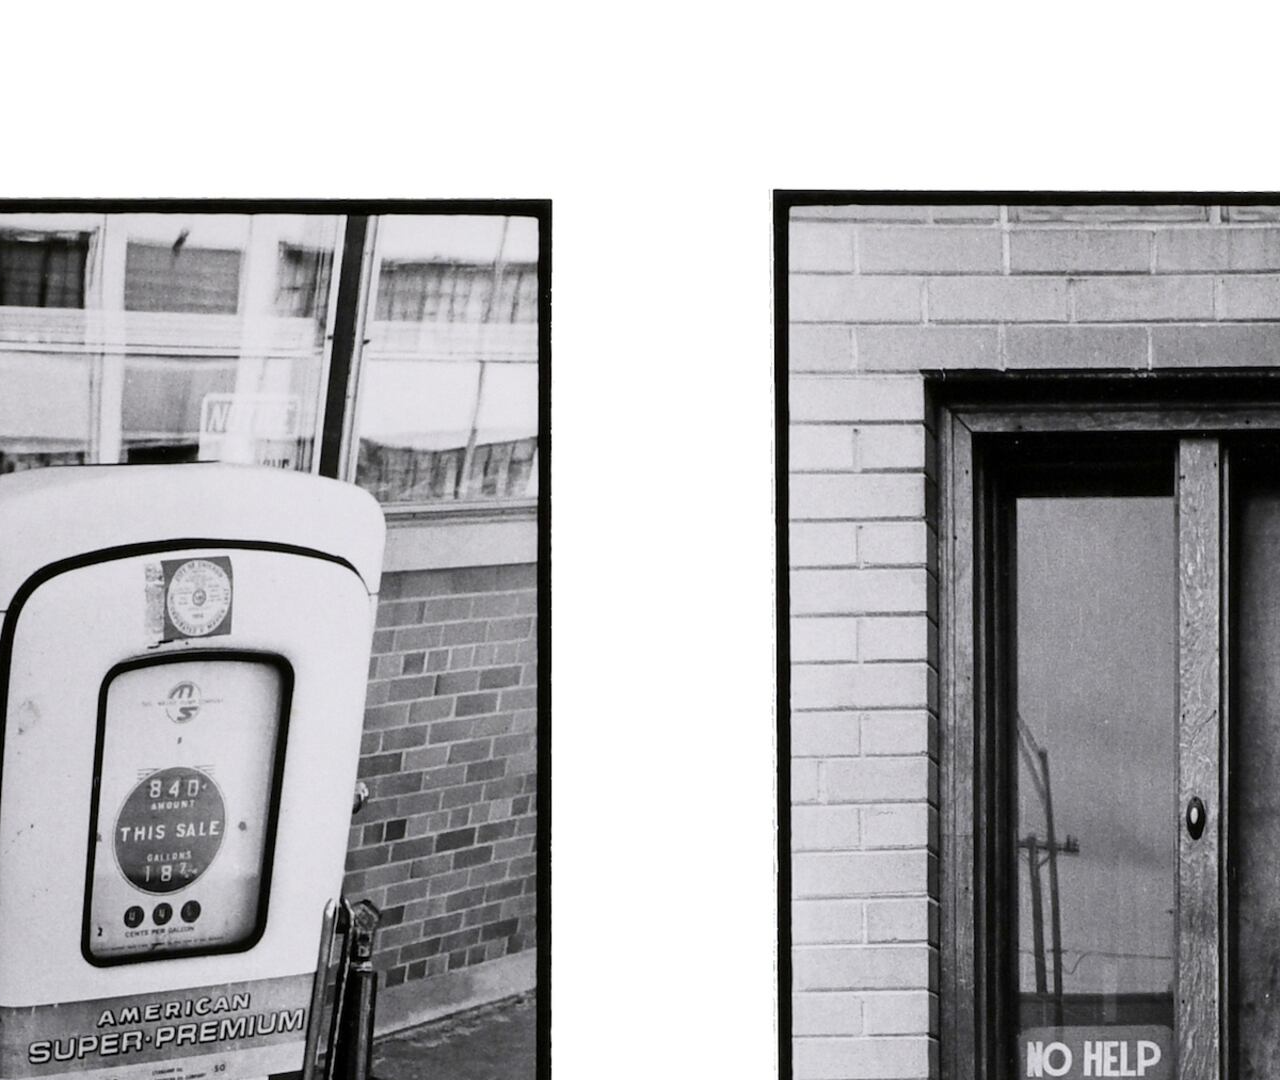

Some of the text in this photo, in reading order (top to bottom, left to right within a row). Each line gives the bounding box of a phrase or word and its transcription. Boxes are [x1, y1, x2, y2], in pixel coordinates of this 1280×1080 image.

[151, 800, 195, 810] AMOUNT
[120, 820, 220, 842] THIS SALE
[147, 850, 192, 862] GALLONS
[125, 929, 149, 938] CENTS
[168, 926, 195, 934] GALLON
[97, 992, 251, 1028] AMERICAN
[1026, 1040, 1162, 1077] NO HELP
